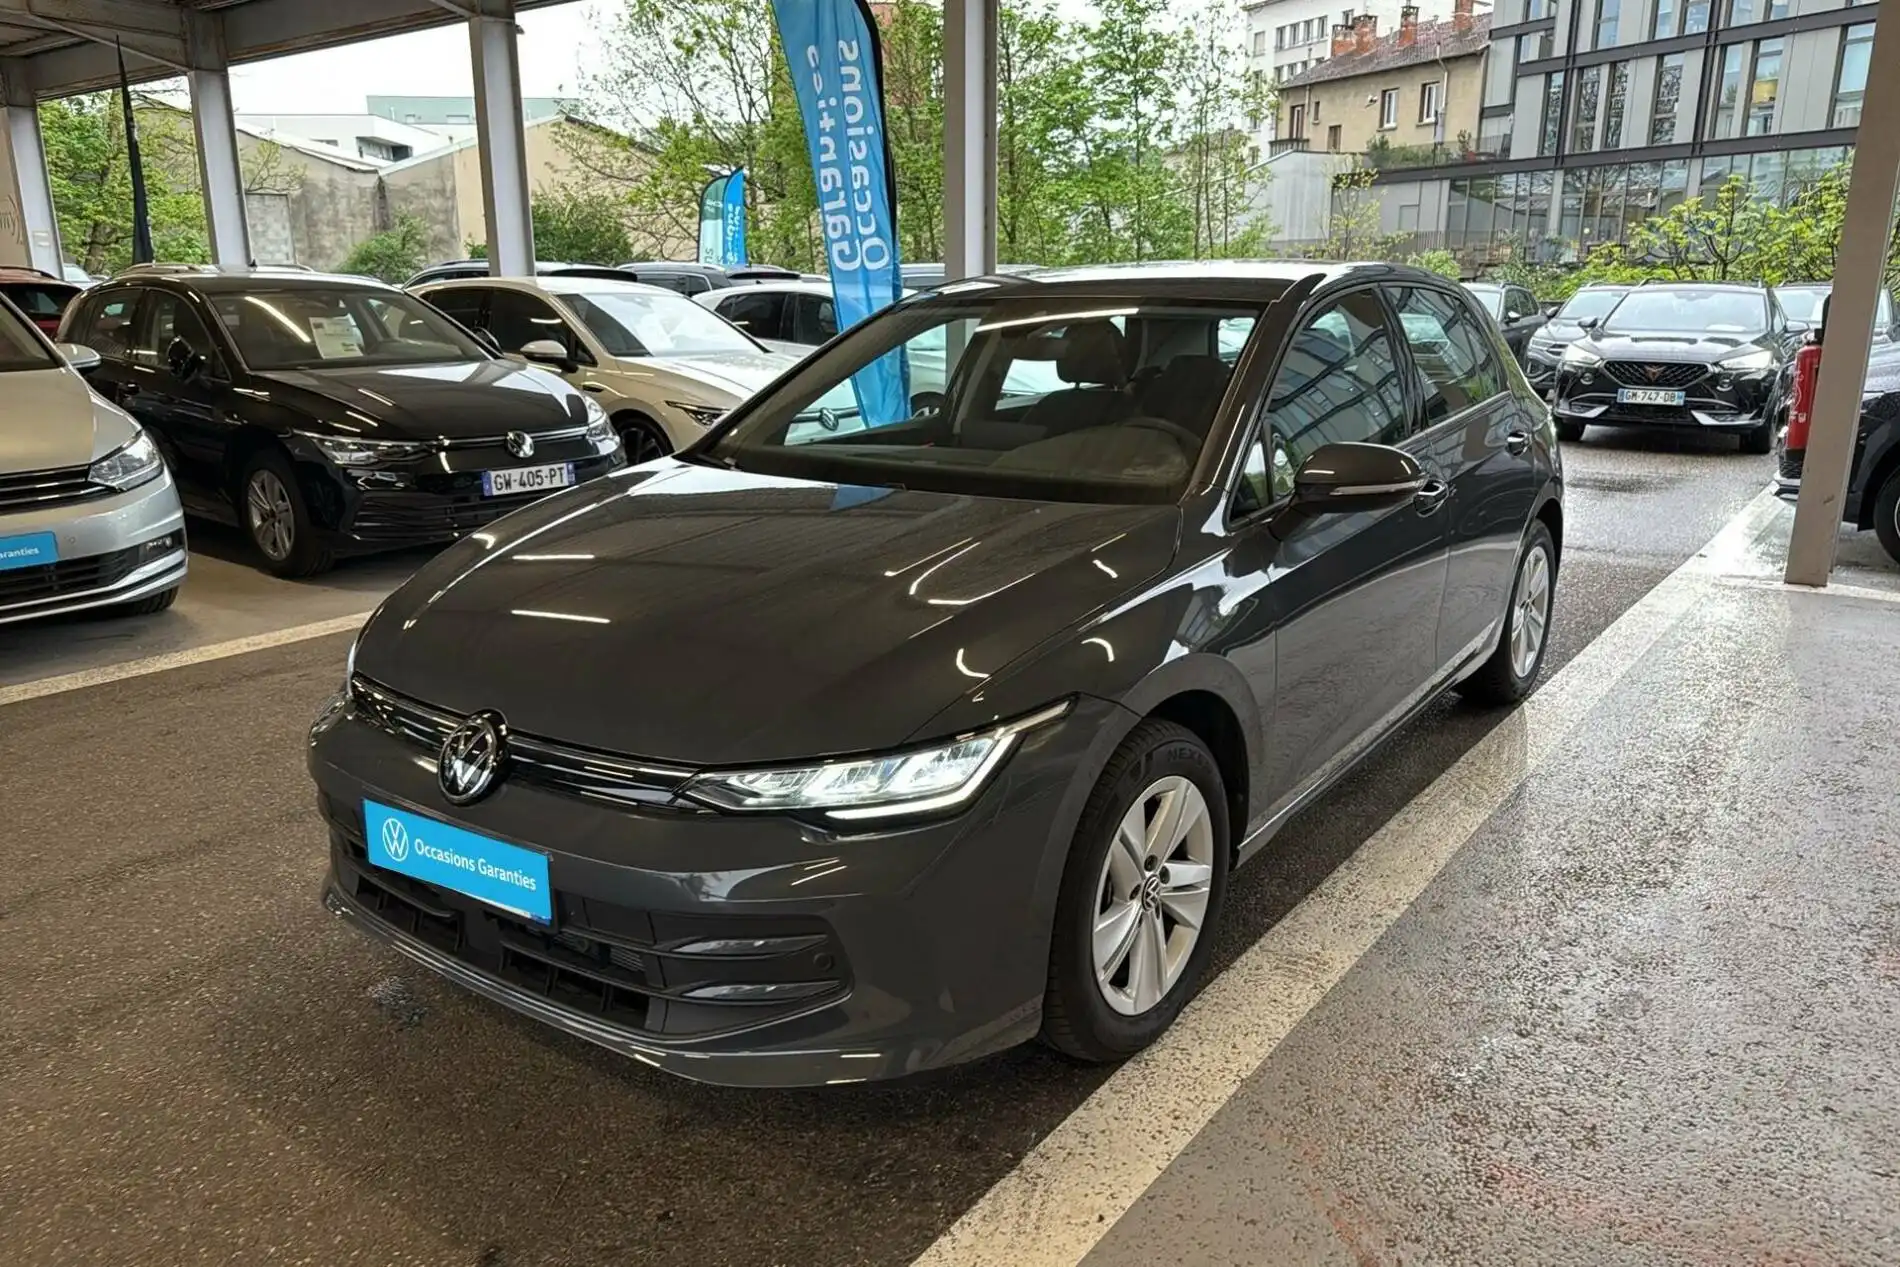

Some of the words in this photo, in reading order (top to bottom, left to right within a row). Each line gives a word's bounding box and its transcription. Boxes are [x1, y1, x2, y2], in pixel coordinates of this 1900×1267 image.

[493, 466, 565, 492] GW-405-PT
[413, 838, 476, 873] Occasions
[477, 858, 537, 891] Garanties
